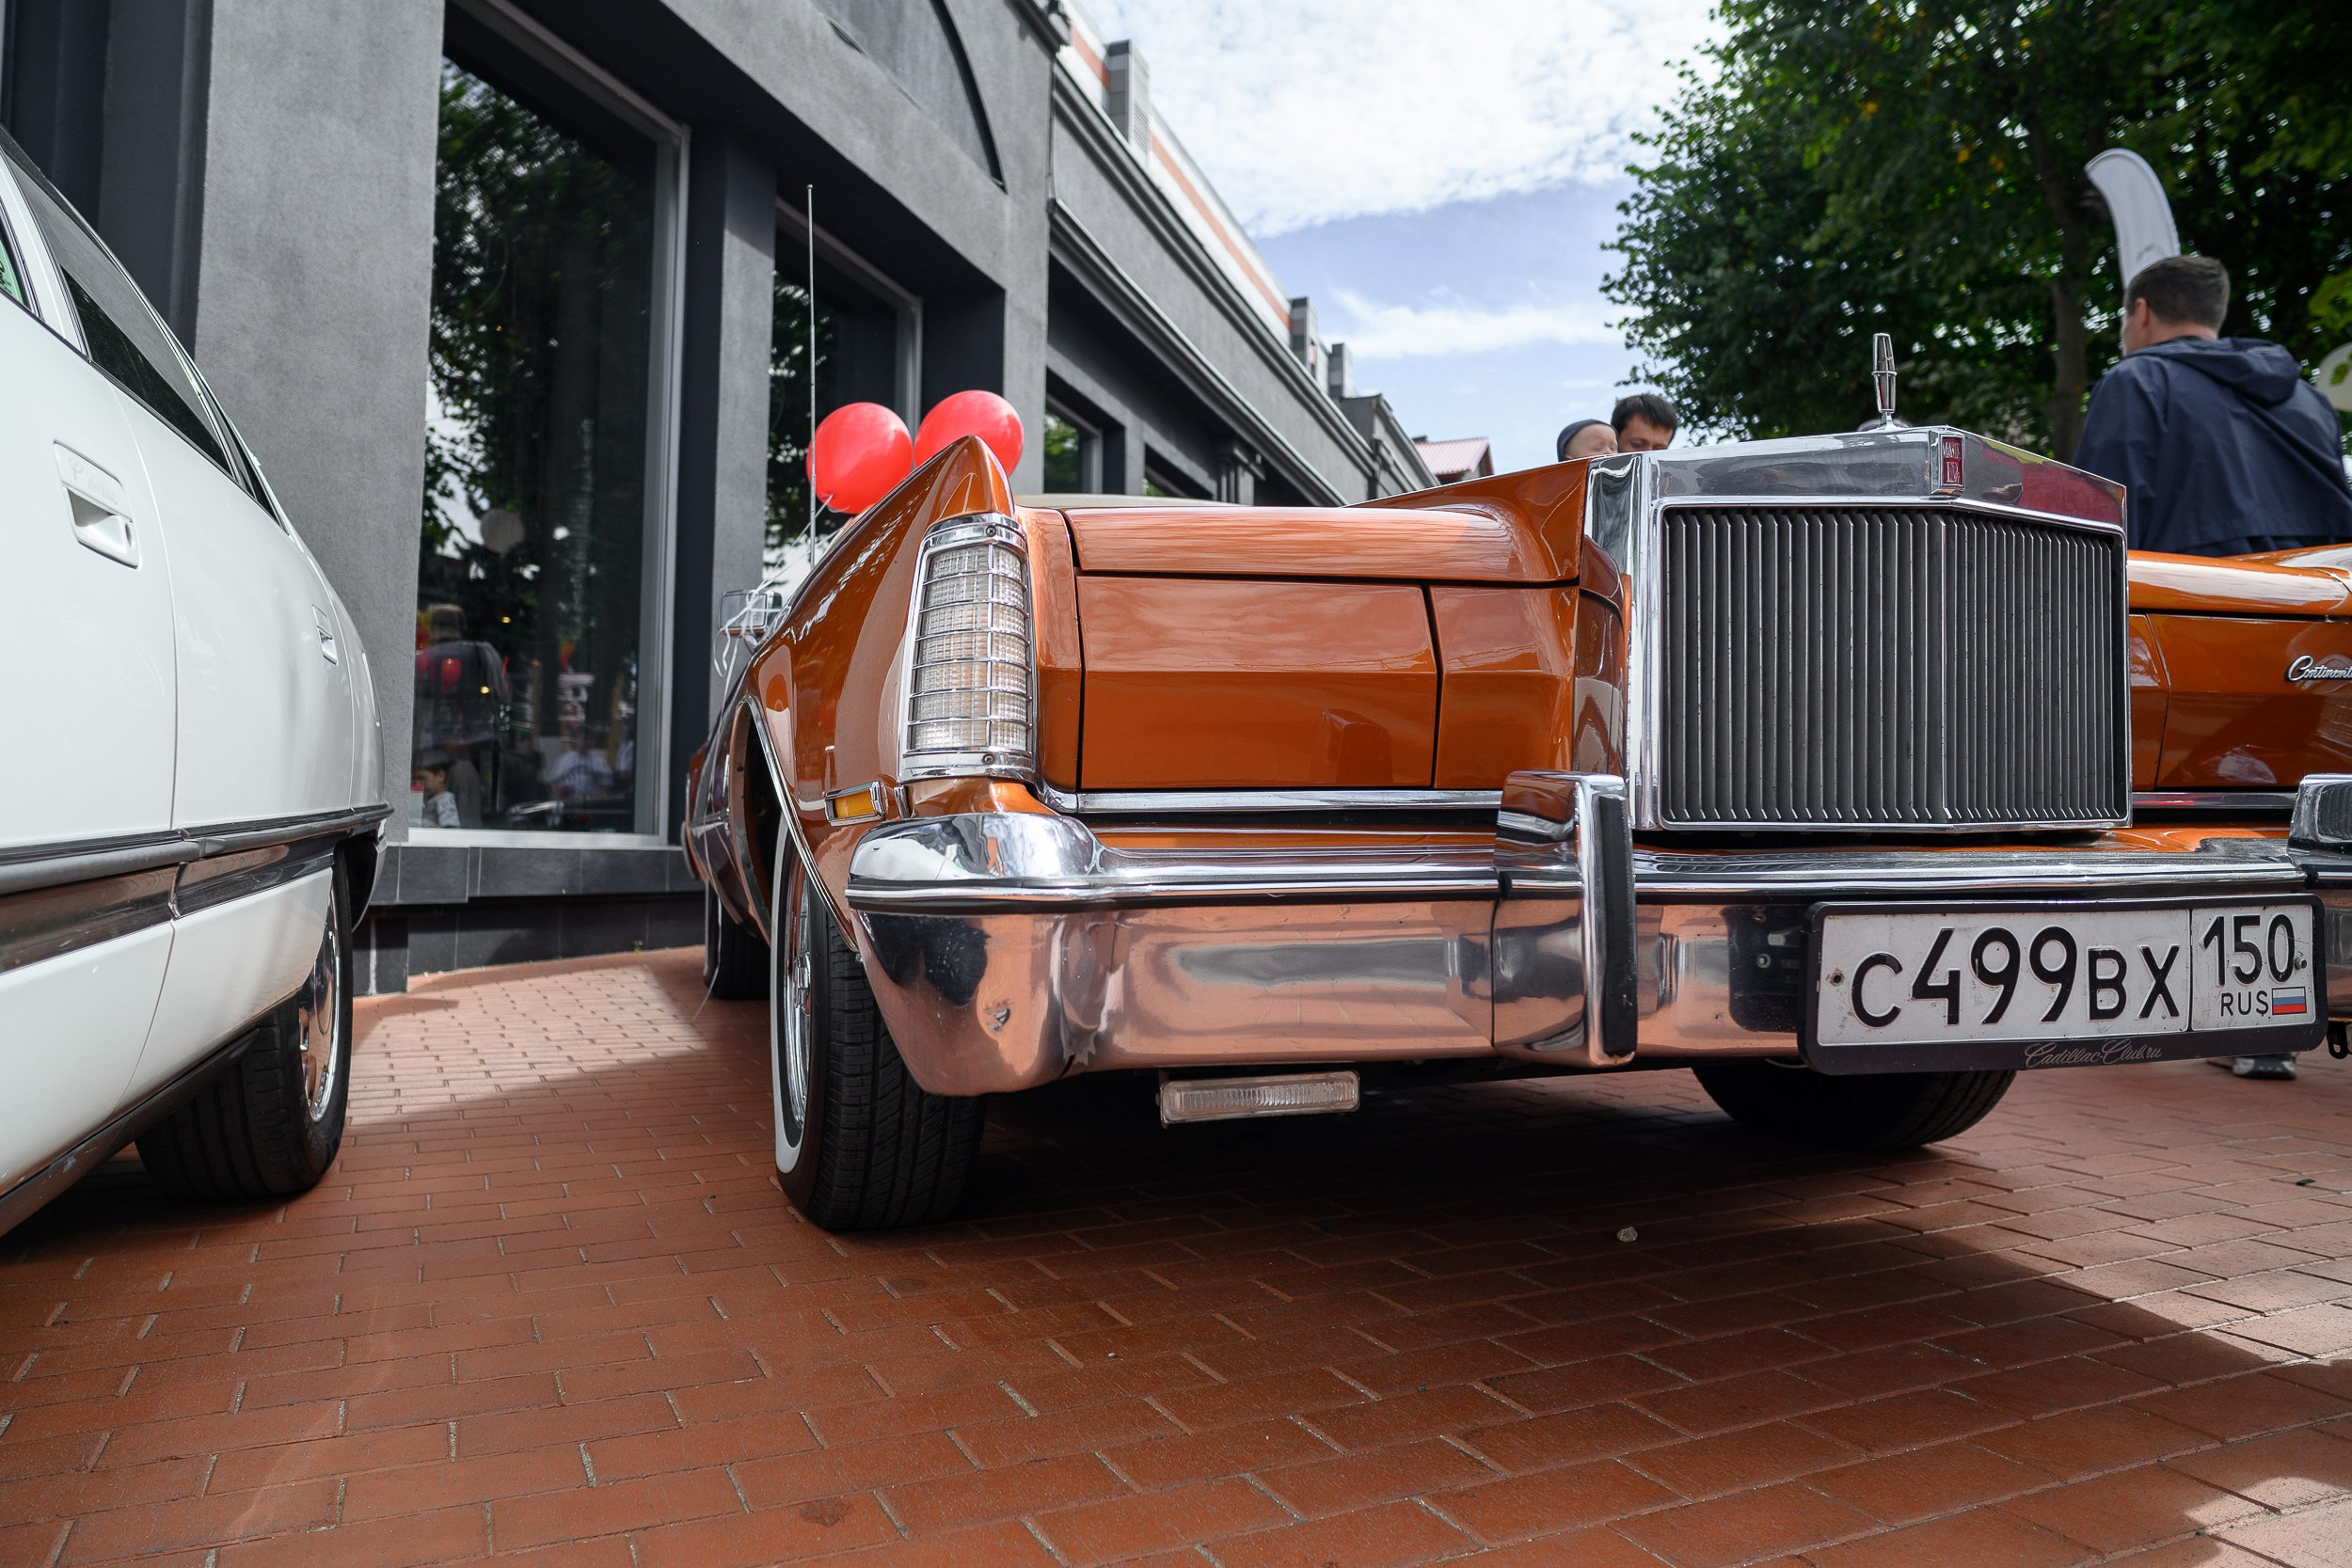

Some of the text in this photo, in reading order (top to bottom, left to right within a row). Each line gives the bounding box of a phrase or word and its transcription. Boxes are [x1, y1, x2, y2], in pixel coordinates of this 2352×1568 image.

[2288, 655, 2352, 681] Continent
[1851, 913, 2296, 1027] C499BX 150
[2220, 990, 2269, 1017] RUS
[2024, 1038, 2163, 1068] Cadillac-Club.ru
